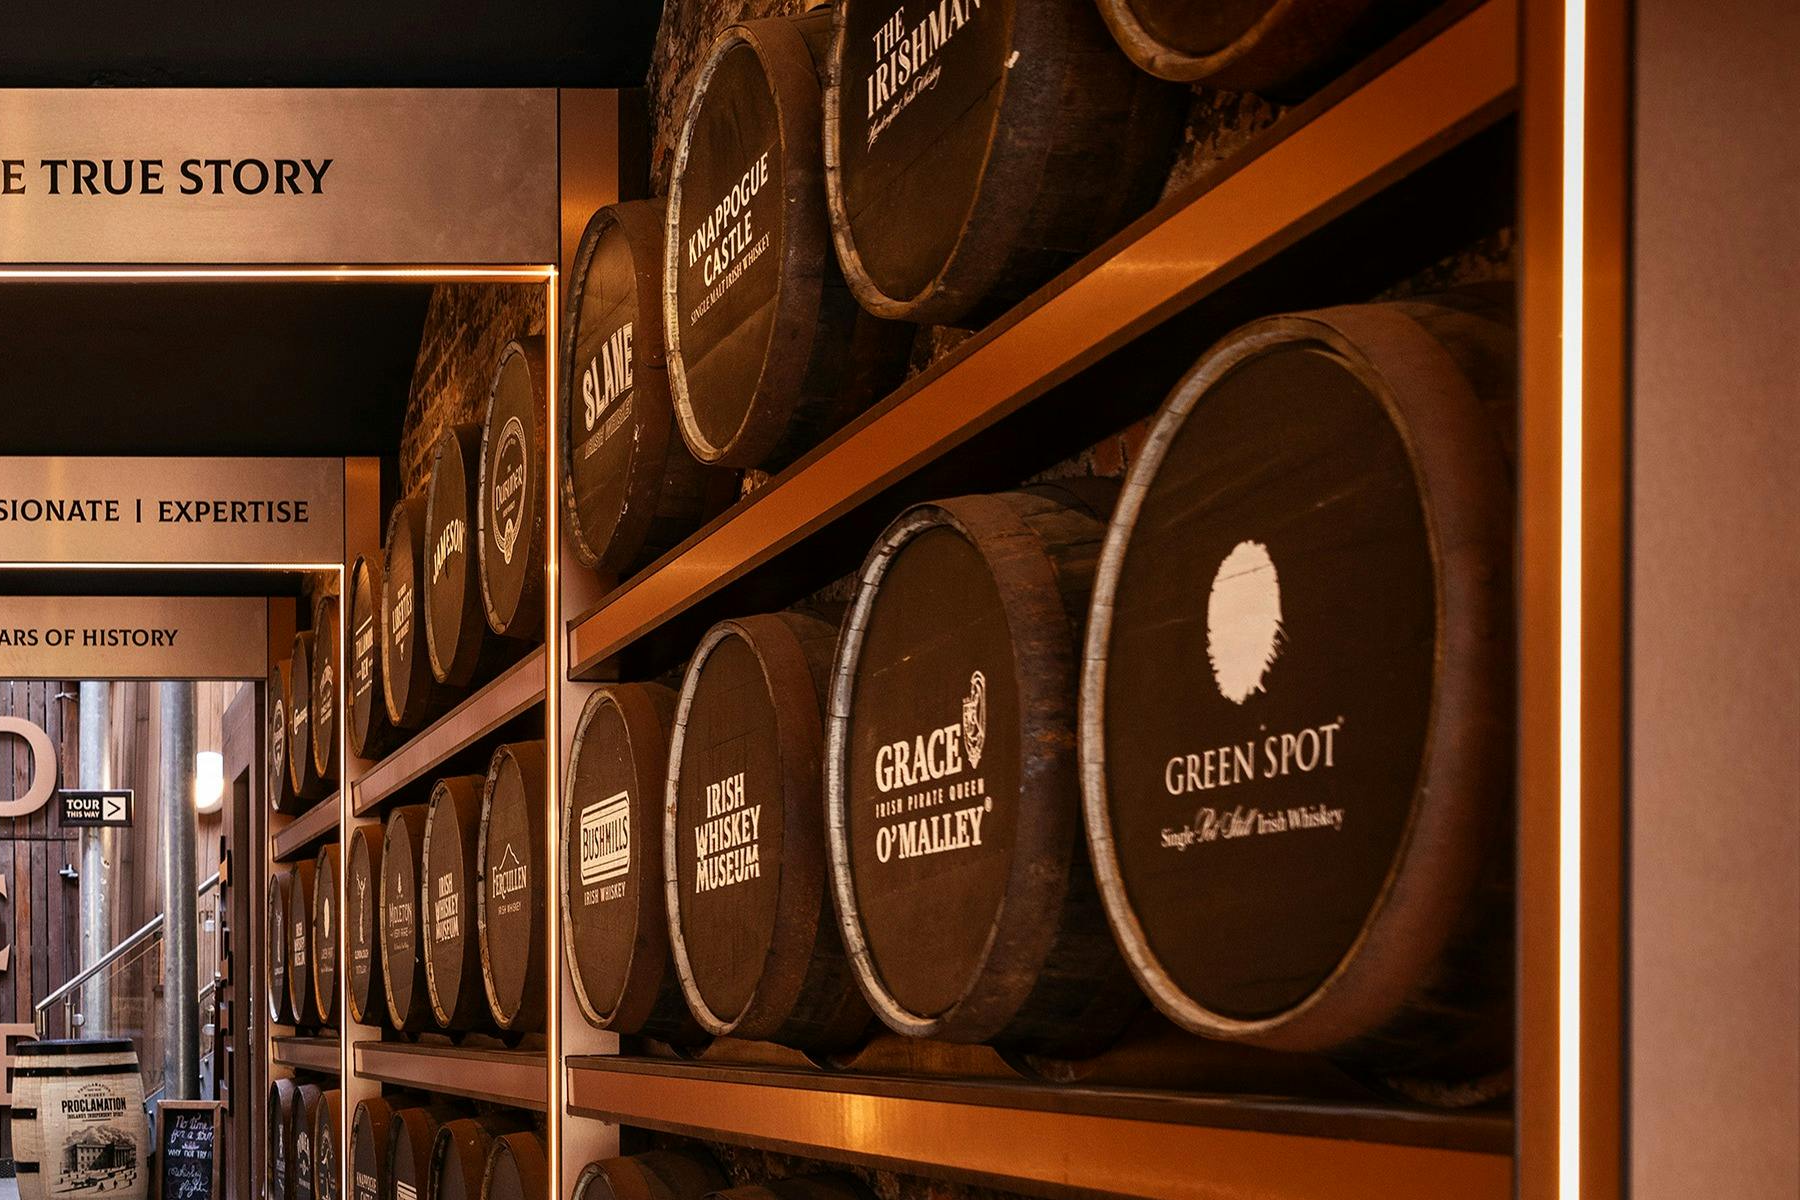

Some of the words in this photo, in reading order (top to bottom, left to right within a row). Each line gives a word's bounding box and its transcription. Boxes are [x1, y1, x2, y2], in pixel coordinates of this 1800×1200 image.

[872, 6, 904, 63] THE
[39, 158, 165, 196] TRUE
[179, 158, 335, 196] STORY
[689, 151, 769, 268] KNAPPOGUE
[703, 210, 753, 288] CASTLE
[742, 231, 772, 278] WHISKEY
[582, 321, 634, 432] SLANE
[157, 499, 311, 525] EXPERTISE
[43, 628, 77, 648] OF
[82, 628, 181, 648] HISTORY
[875, 722, 963, 794] GRACE
[1164, 741, 1256, 796] GREEN
[1263, 722, 1341, 779] SPOT
[66, 799, 100, 810] TOUR
[706, 771, 746, 818] IRISH
[875, 799, 904, 819] IRISH
[908, 789, 945, 811] PIRATE
[948, 778, 985, 802] QUEEN
[583, 815, 628, 863] BUSHMILLS
[694, 804, 761, 862] WHISKEY
[875, 805, 984, 864] O'MALLEY
[695, 845, 761, 895] MUSEUM
[61, 1096, 127, 1113] PROCLAMATION
